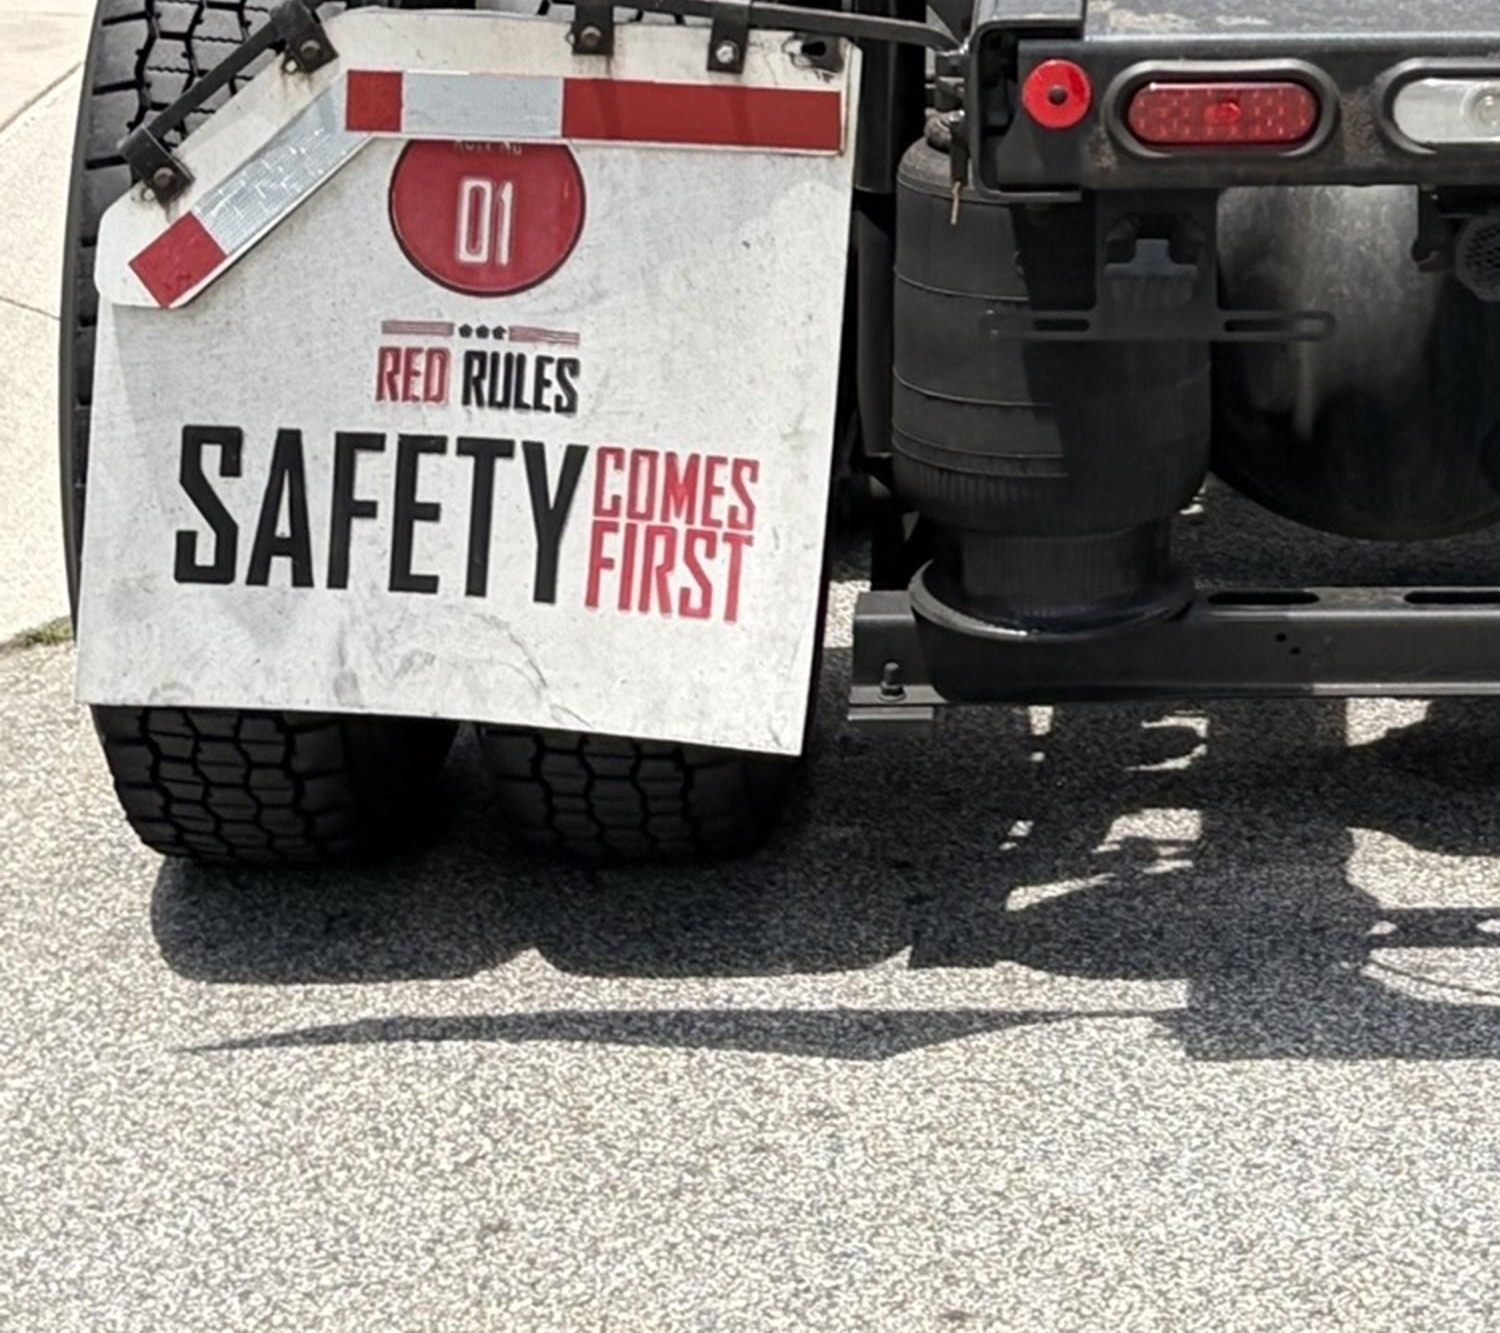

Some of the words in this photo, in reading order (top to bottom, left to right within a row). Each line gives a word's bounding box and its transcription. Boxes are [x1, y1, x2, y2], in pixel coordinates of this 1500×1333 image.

[456, 178, 513, 266] 01
[375, 345, 451, 404] RED
[461, 349, 581, 415] RULES
[174, 424, 589, 605] SAFETY
[592, 446, 760, 532] COMES
[584, 519, 755, 624] FIRST
